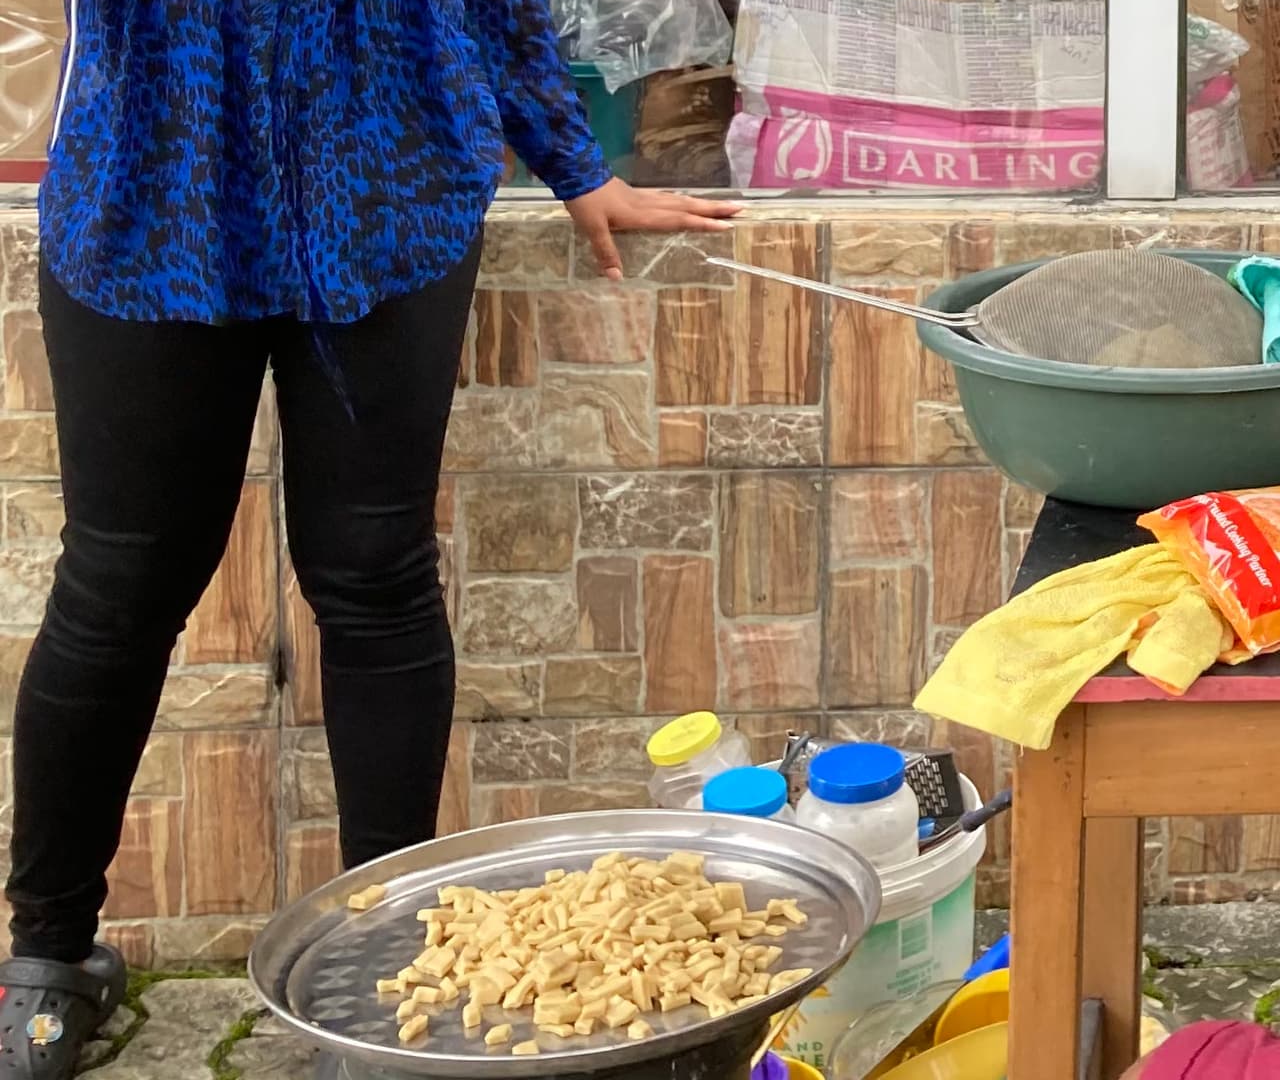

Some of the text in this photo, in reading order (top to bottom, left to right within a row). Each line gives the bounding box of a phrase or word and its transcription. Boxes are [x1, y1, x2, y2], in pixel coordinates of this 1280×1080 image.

[859, 144, 1099, 182] DARLING
[1223, 524, 1253, 558] Cooking
[1245, 553, 1273, 588] Partner
